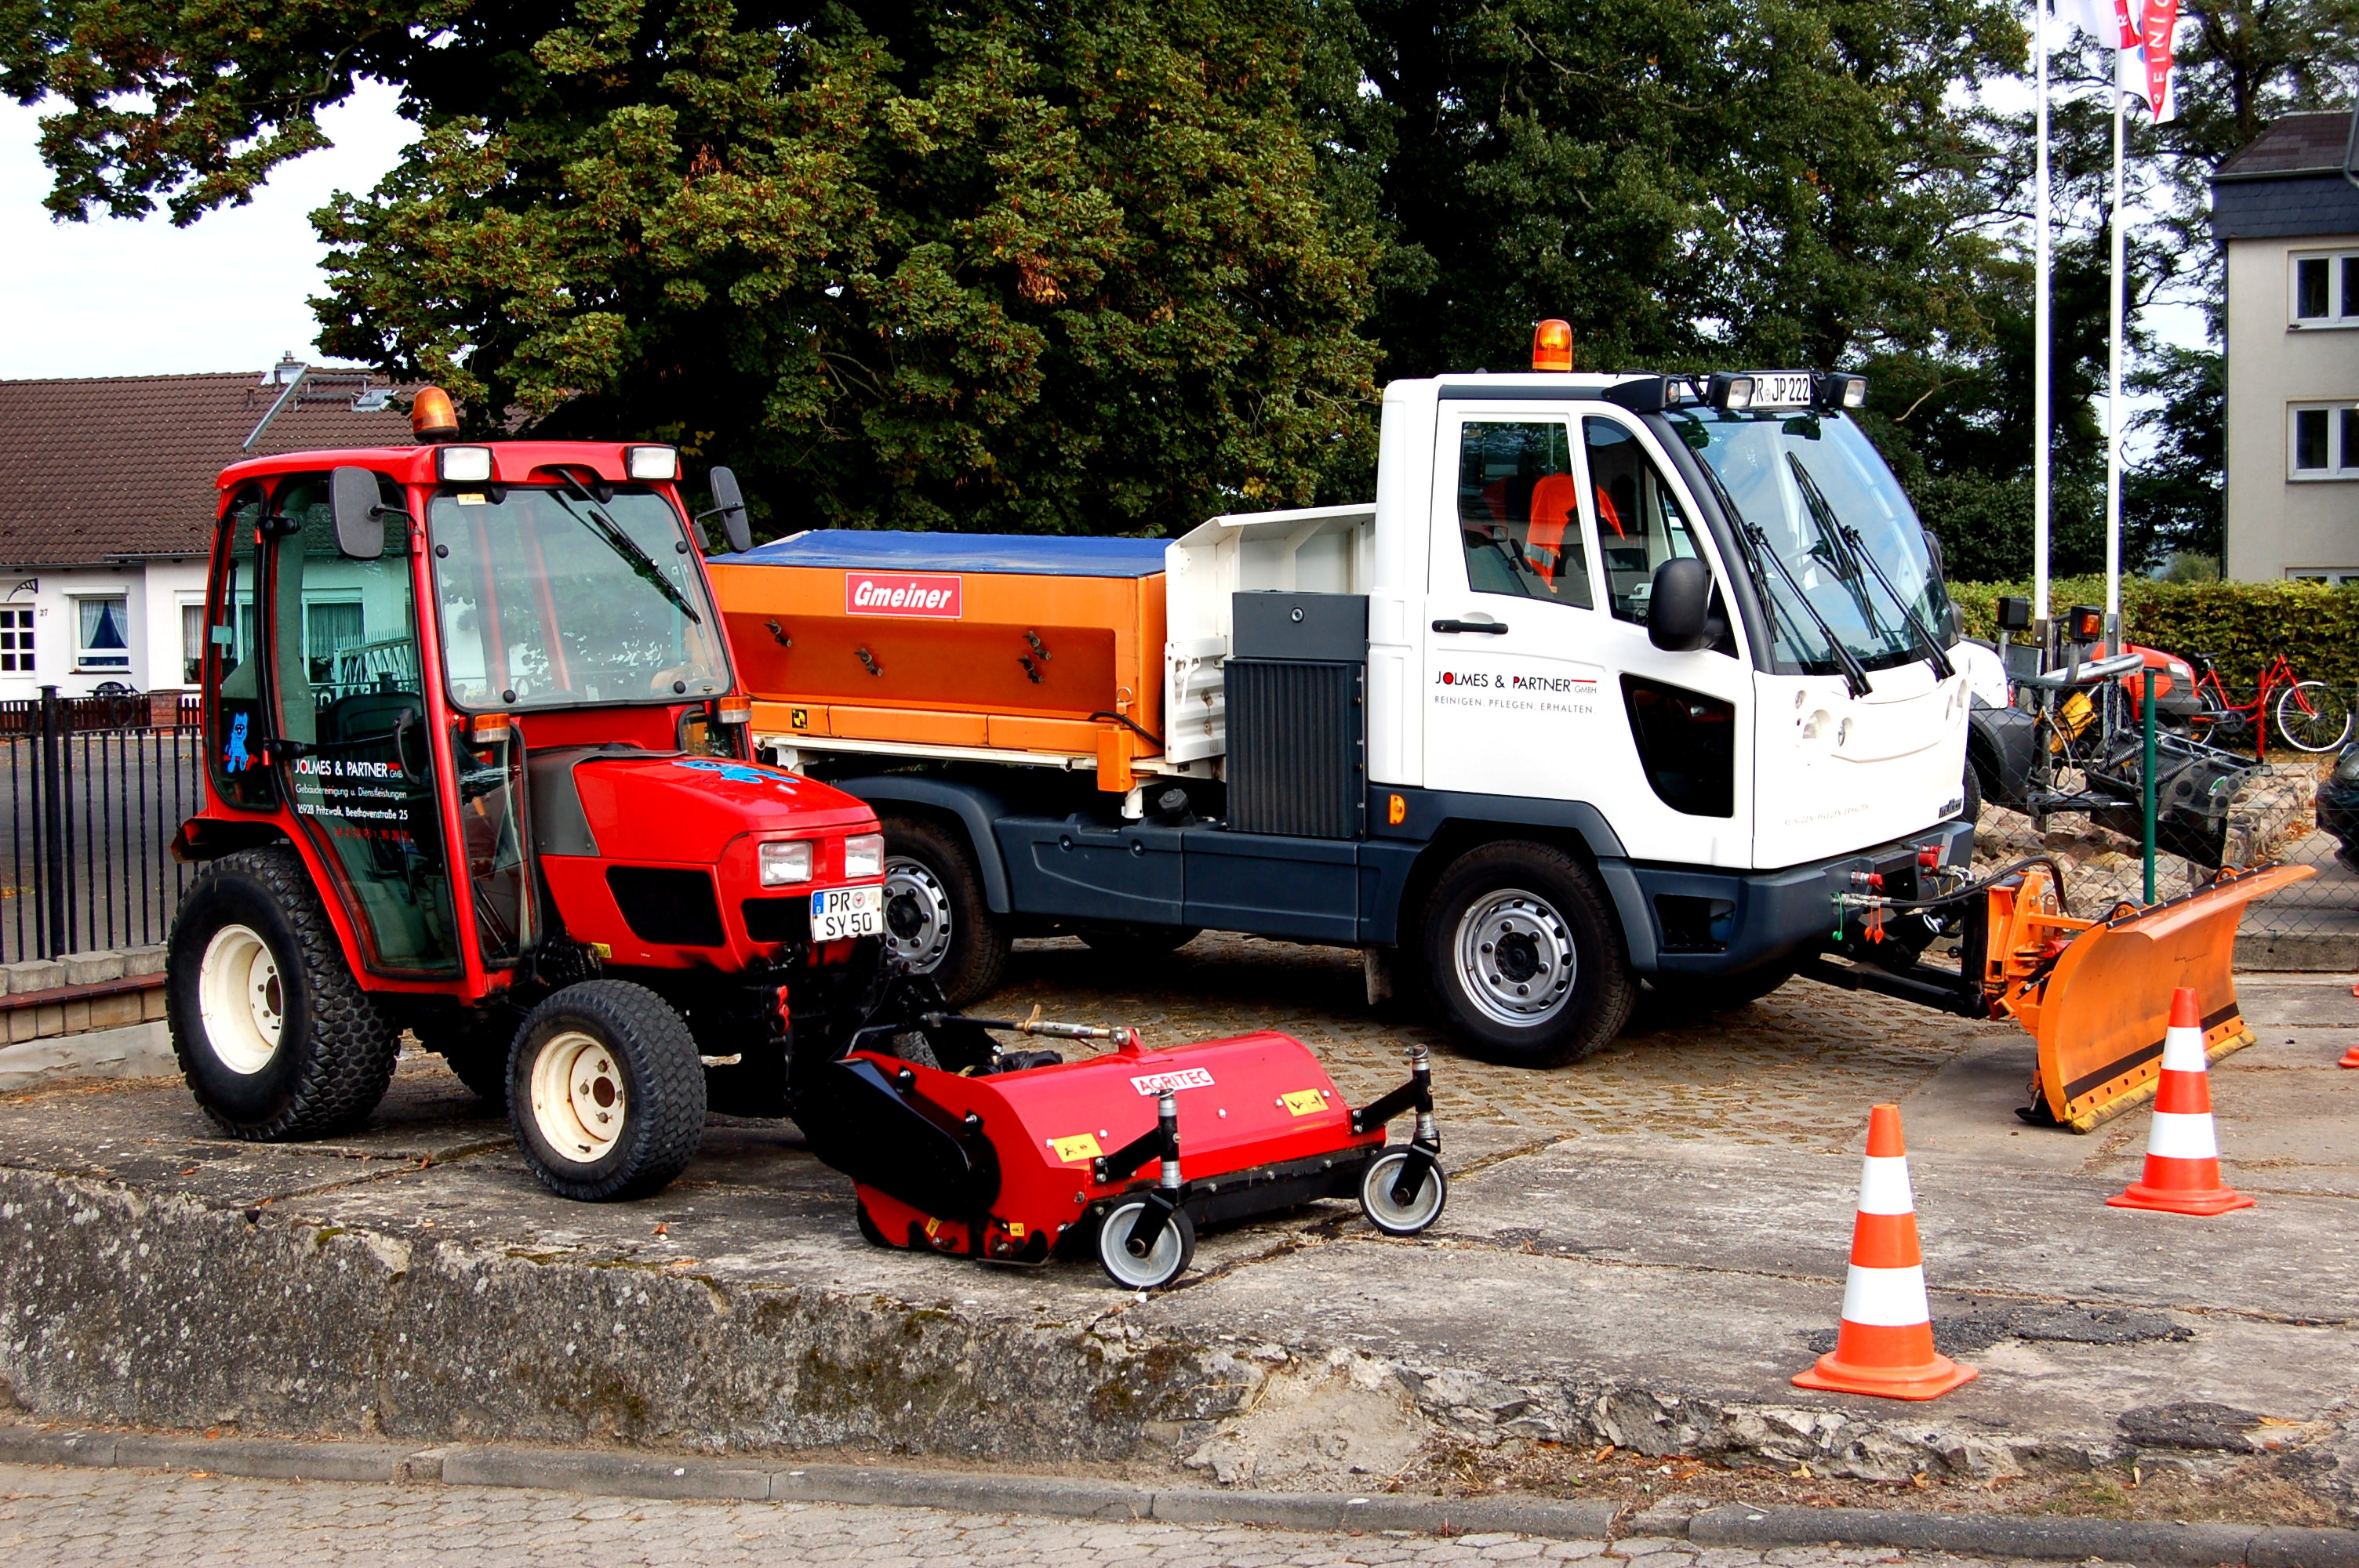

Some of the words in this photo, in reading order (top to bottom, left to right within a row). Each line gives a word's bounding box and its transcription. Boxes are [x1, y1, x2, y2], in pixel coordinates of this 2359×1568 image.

[1772, 377, 1787, 402] JP
[1789, 377, 1809, 401] 222
[854, 580, 953, 609] Gmeiner
[1435, 670, 1488, 688] JOLMES
[1495, 674, 1505, 688] &
[1513, 676, 1571, 693] PARTNER
[1574, 685, 1597, 694] GMBH
[1434, 695, 1485, 707] REINIGEN.
[1488, 699, 1536, 710] PFLEGEN.
[1540, 702, 1596, 714] ERHALTEN.
[295, 759, 332, 776] JOLMES
[335, 762, 343, 776] &
[347, 761, 388, 778] PARTNER
[398, 809, 409, 820] 25
[829, 891, 850, 913] PR
[825, 914, 846, 936] SY
[851, 912, 872, 933] 50
[1139, 1070, 1211, 1093] AGRITEC
